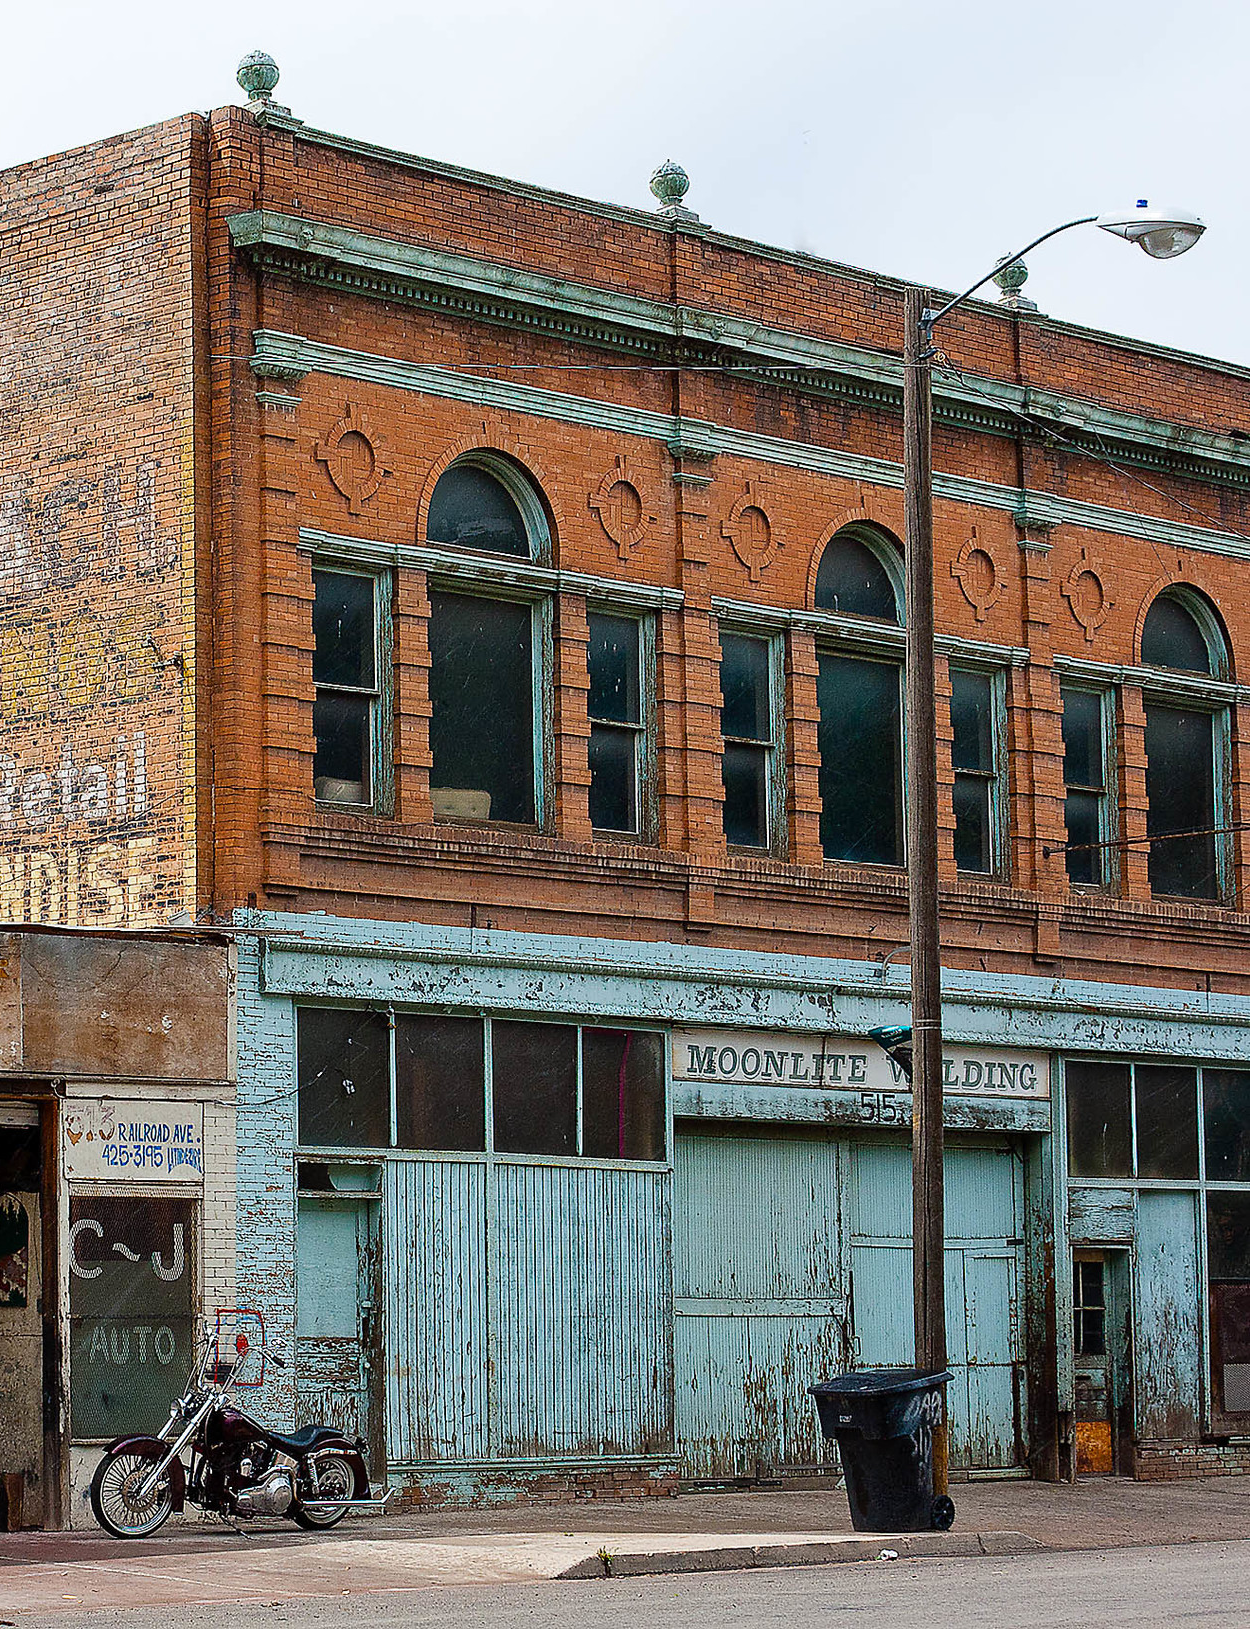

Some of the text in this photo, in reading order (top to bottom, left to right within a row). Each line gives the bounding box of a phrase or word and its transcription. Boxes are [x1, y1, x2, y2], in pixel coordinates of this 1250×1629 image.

[686, 1044, 1037, 1091] MOONLITE WLDING
[859, 1092, 898, 1122] 515
[117, 1121, 171, 1143] RAILROAD
[172, 1123, 202, 1144] AVE.
[88, 1325, 177, 1365] AUTO
